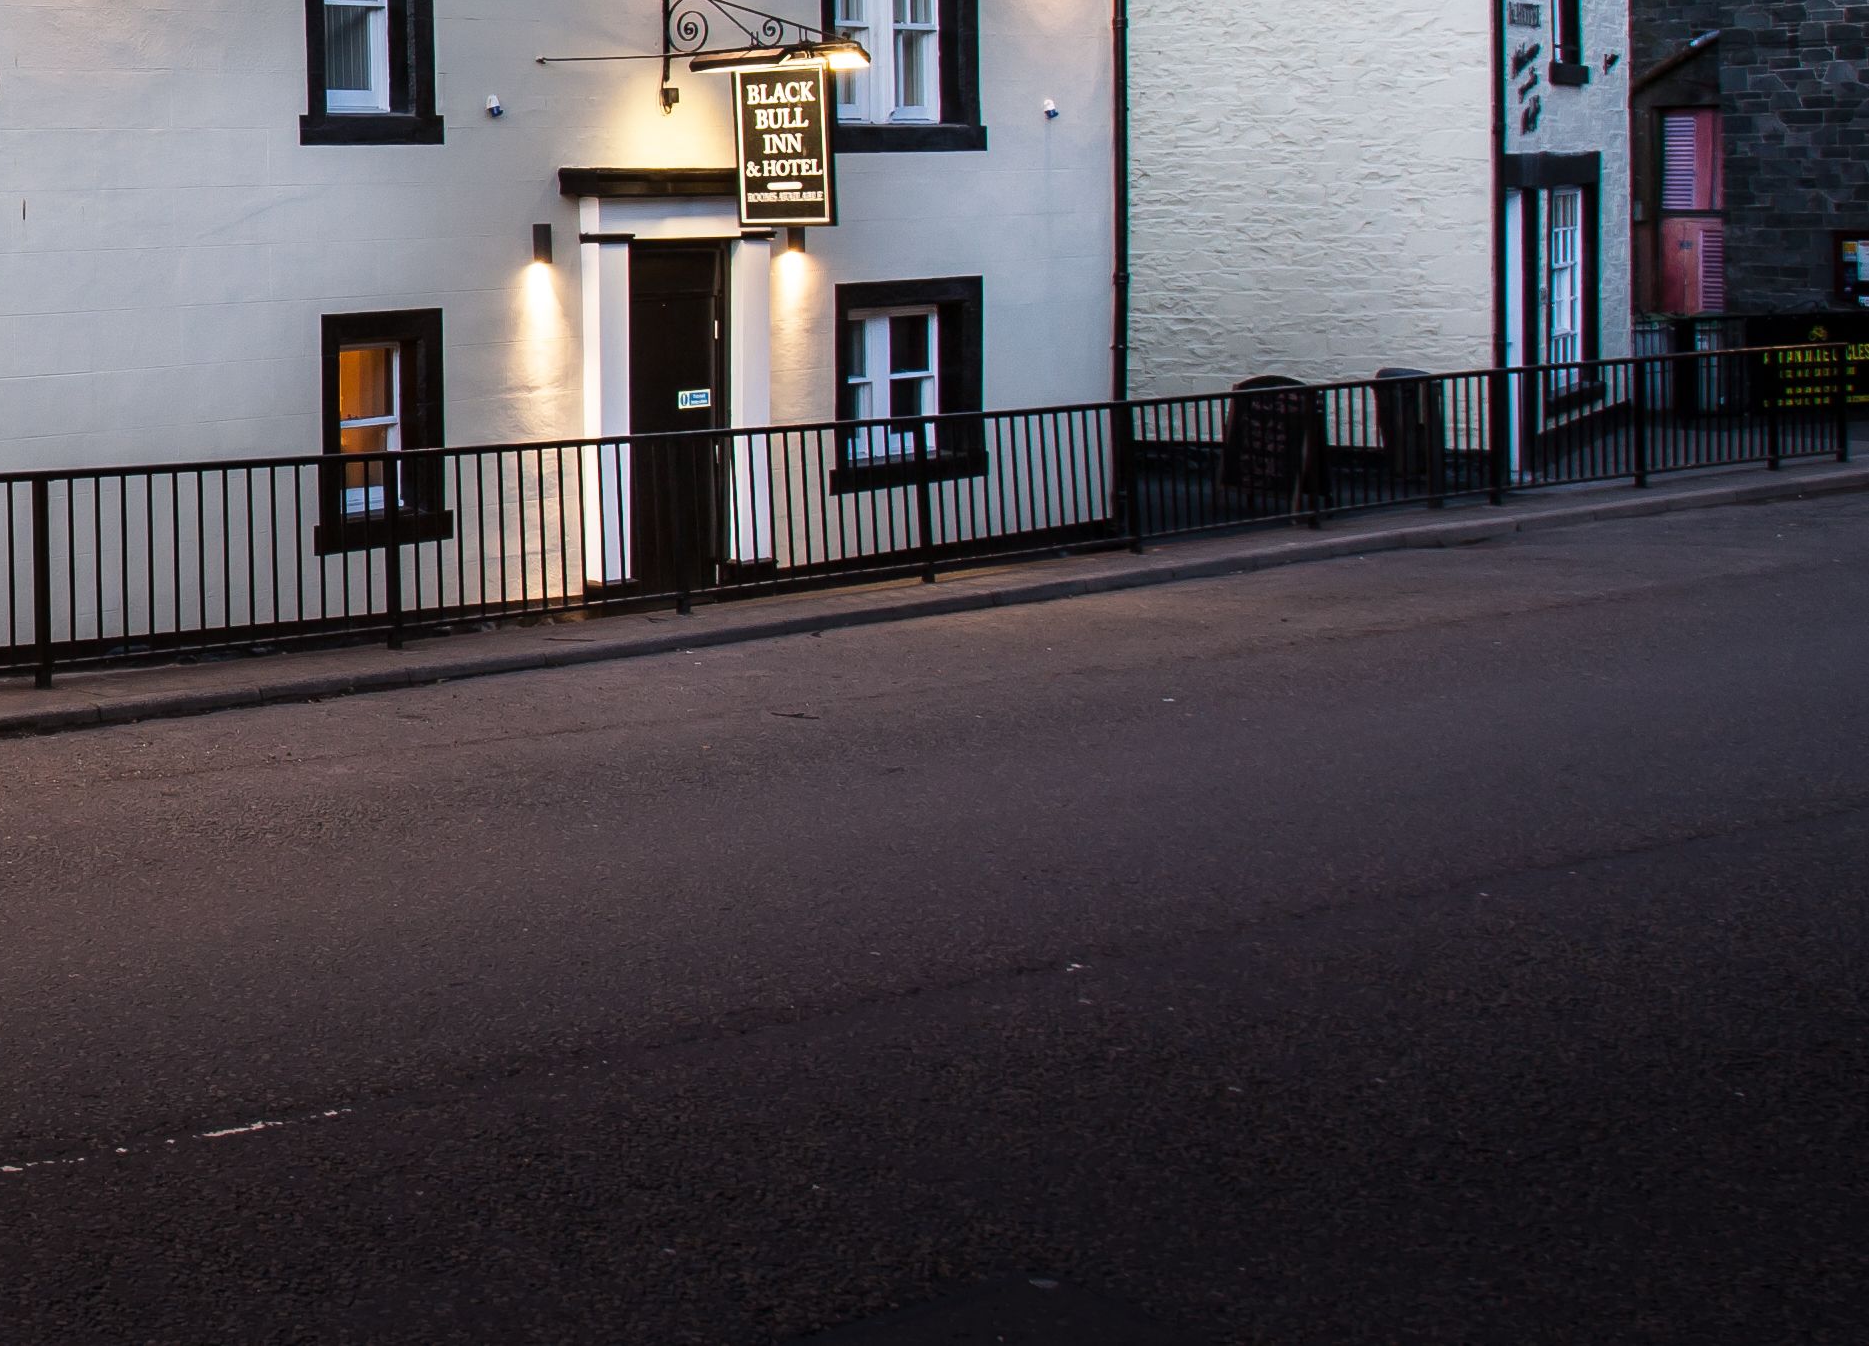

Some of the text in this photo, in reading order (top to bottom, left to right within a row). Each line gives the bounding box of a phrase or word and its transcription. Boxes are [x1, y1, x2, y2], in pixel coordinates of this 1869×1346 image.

[746, 80, 816, 105] BLACK
[755, 107, 809, 129] BULL
[763, 133, 803, 154] INN
[746, 159, 823, 177] & HOTEL
